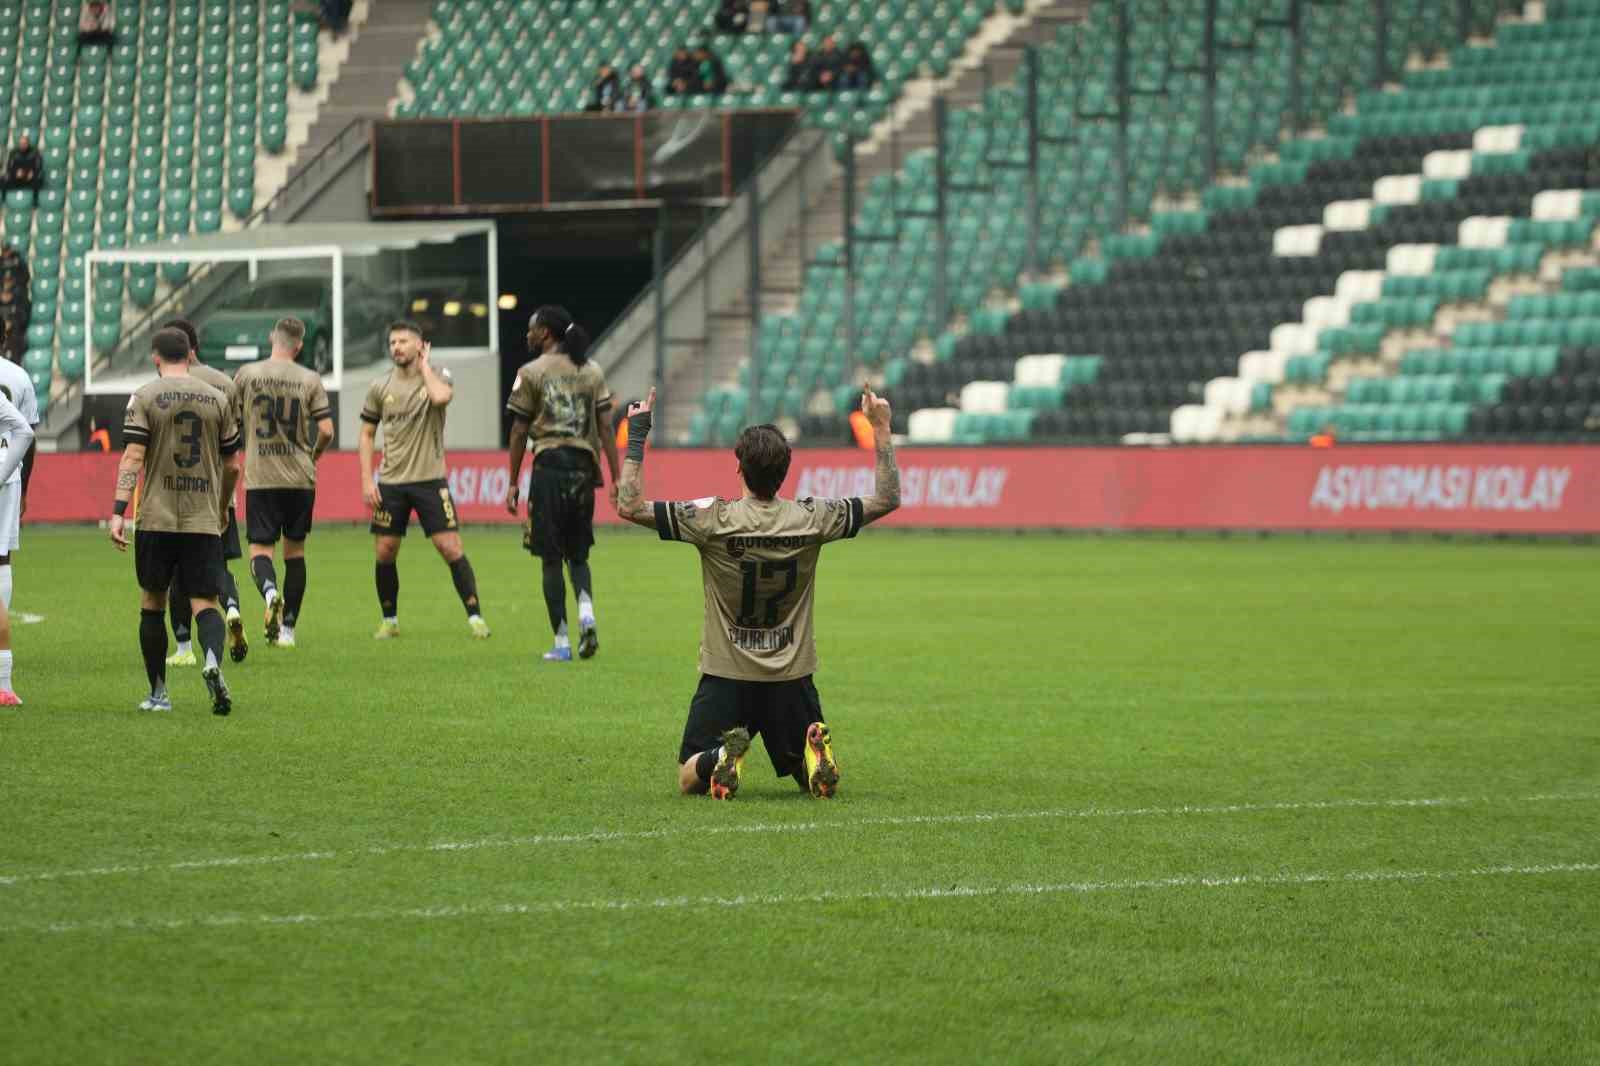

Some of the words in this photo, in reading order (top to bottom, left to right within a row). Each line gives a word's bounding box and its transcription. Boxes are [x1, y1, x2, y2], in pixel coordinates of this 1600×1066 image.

[161, 391, 217, 405] AUTOPORT
[252, 394, 300, 443] 34
[173, 410, 202, 468] 3
[926, 465, 1008, 508] KOLAY
[1472, 464, 1572, 511] KOLAY
[736, 536, 806, 550] AUTOPORT
[739, 560, 797, 628] 17
